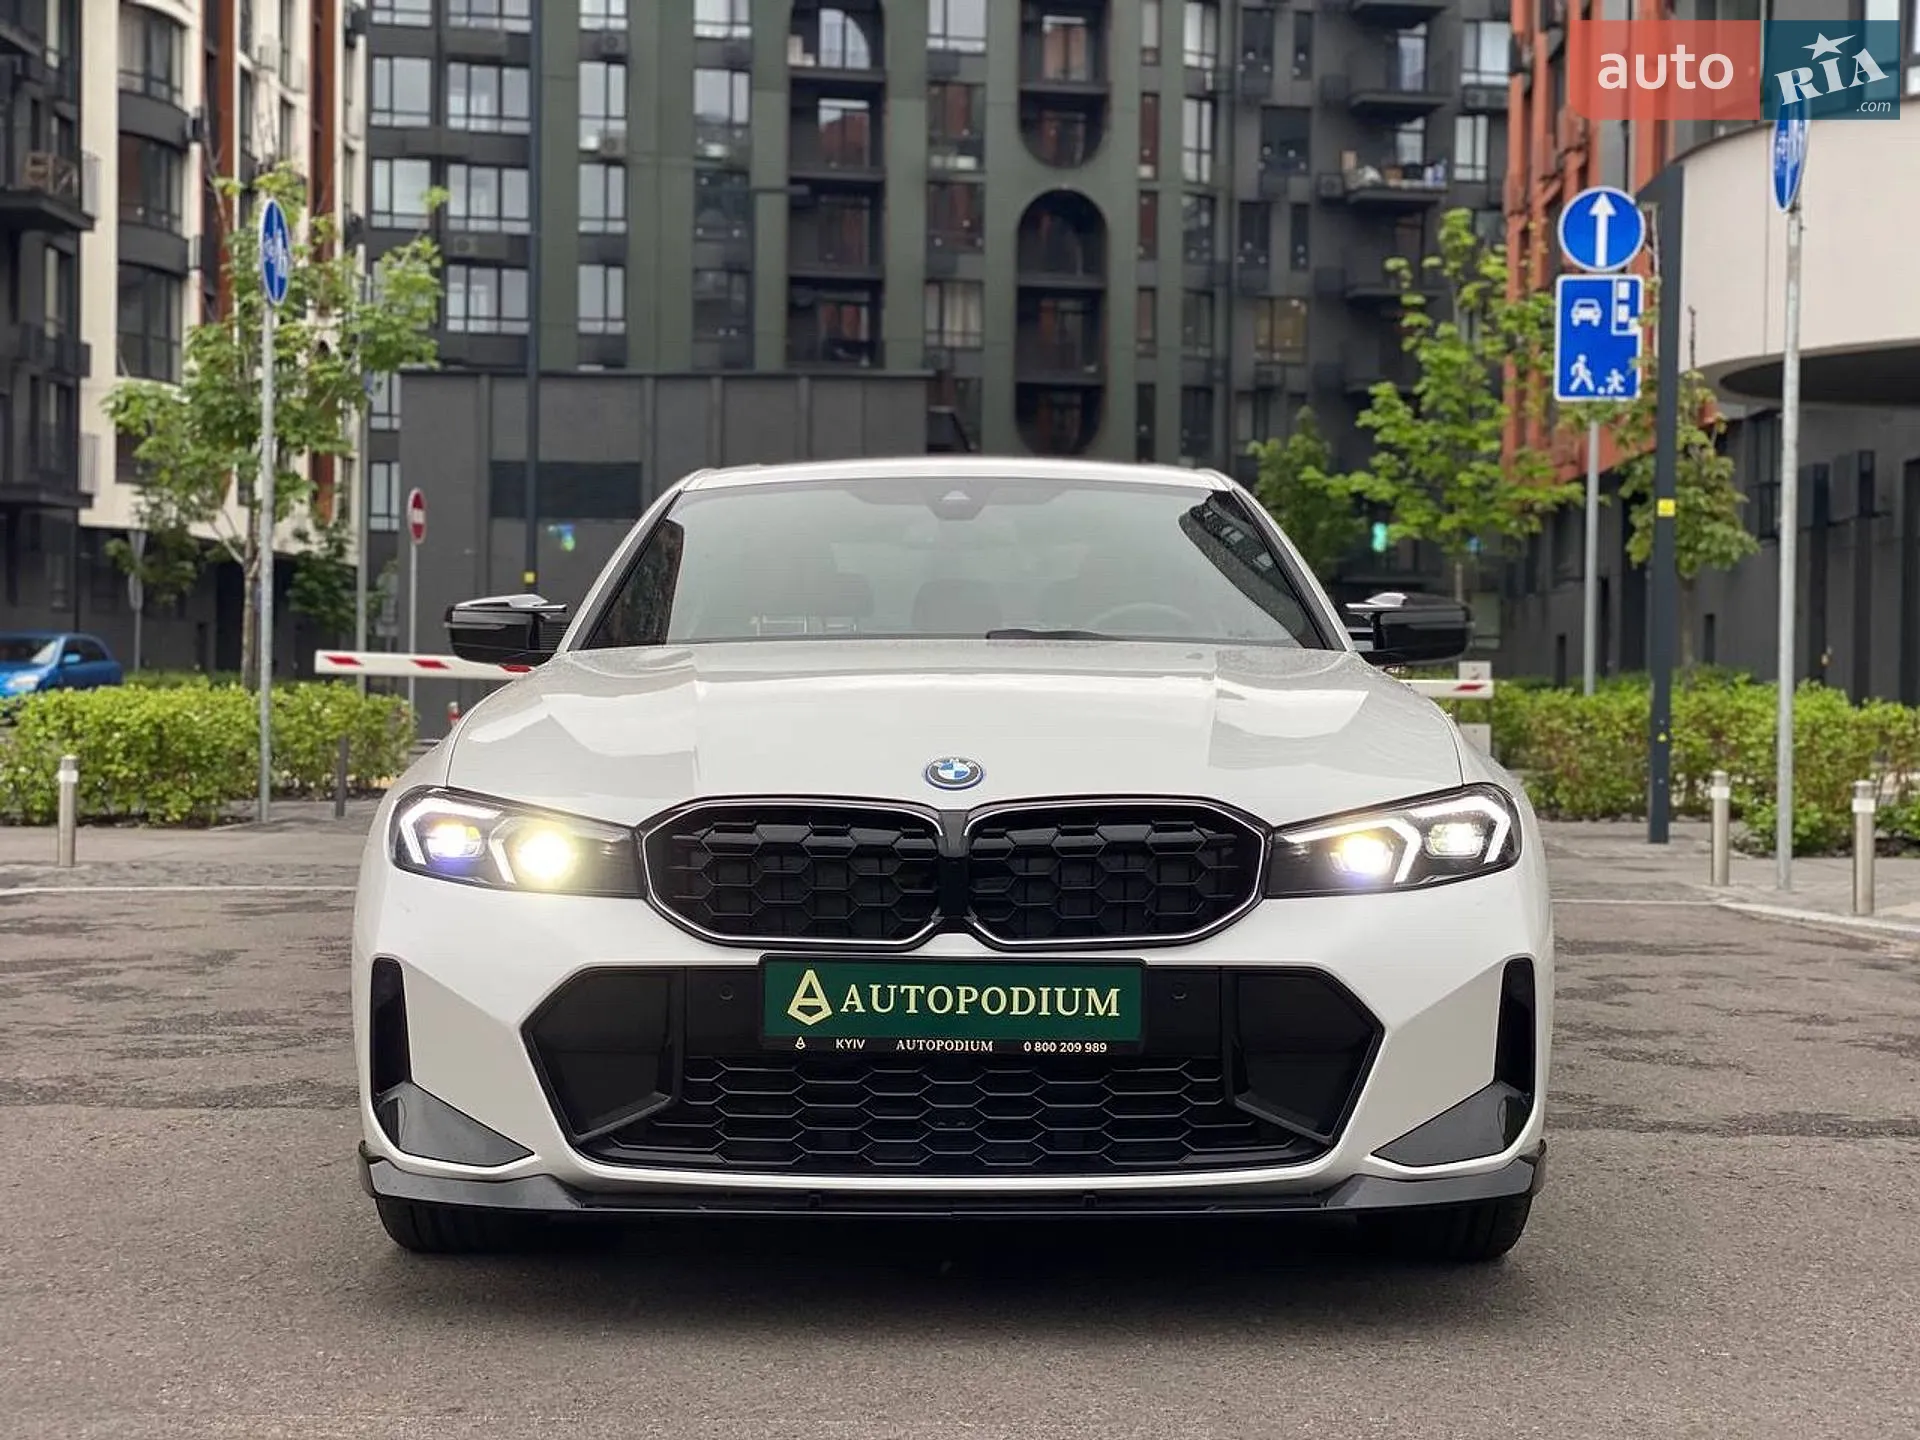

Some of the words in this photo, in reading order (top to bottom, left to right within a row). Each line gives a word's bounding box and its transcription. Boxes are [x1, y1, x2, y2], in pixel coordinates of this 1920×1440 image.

[840, 983, 1121, 1017] AUTOPODIUM
[835, 1038, 866, 1050] KYIV
[896, 1039, 994, 1052] AUTOPODIUM
[1023, 1042, 1031, 1053] 0
[1034, 1042, 1057, 1053] 800
[1060, 1042, 1083, 1053] 209
[1085, 1042, 1108, 1053] 989
